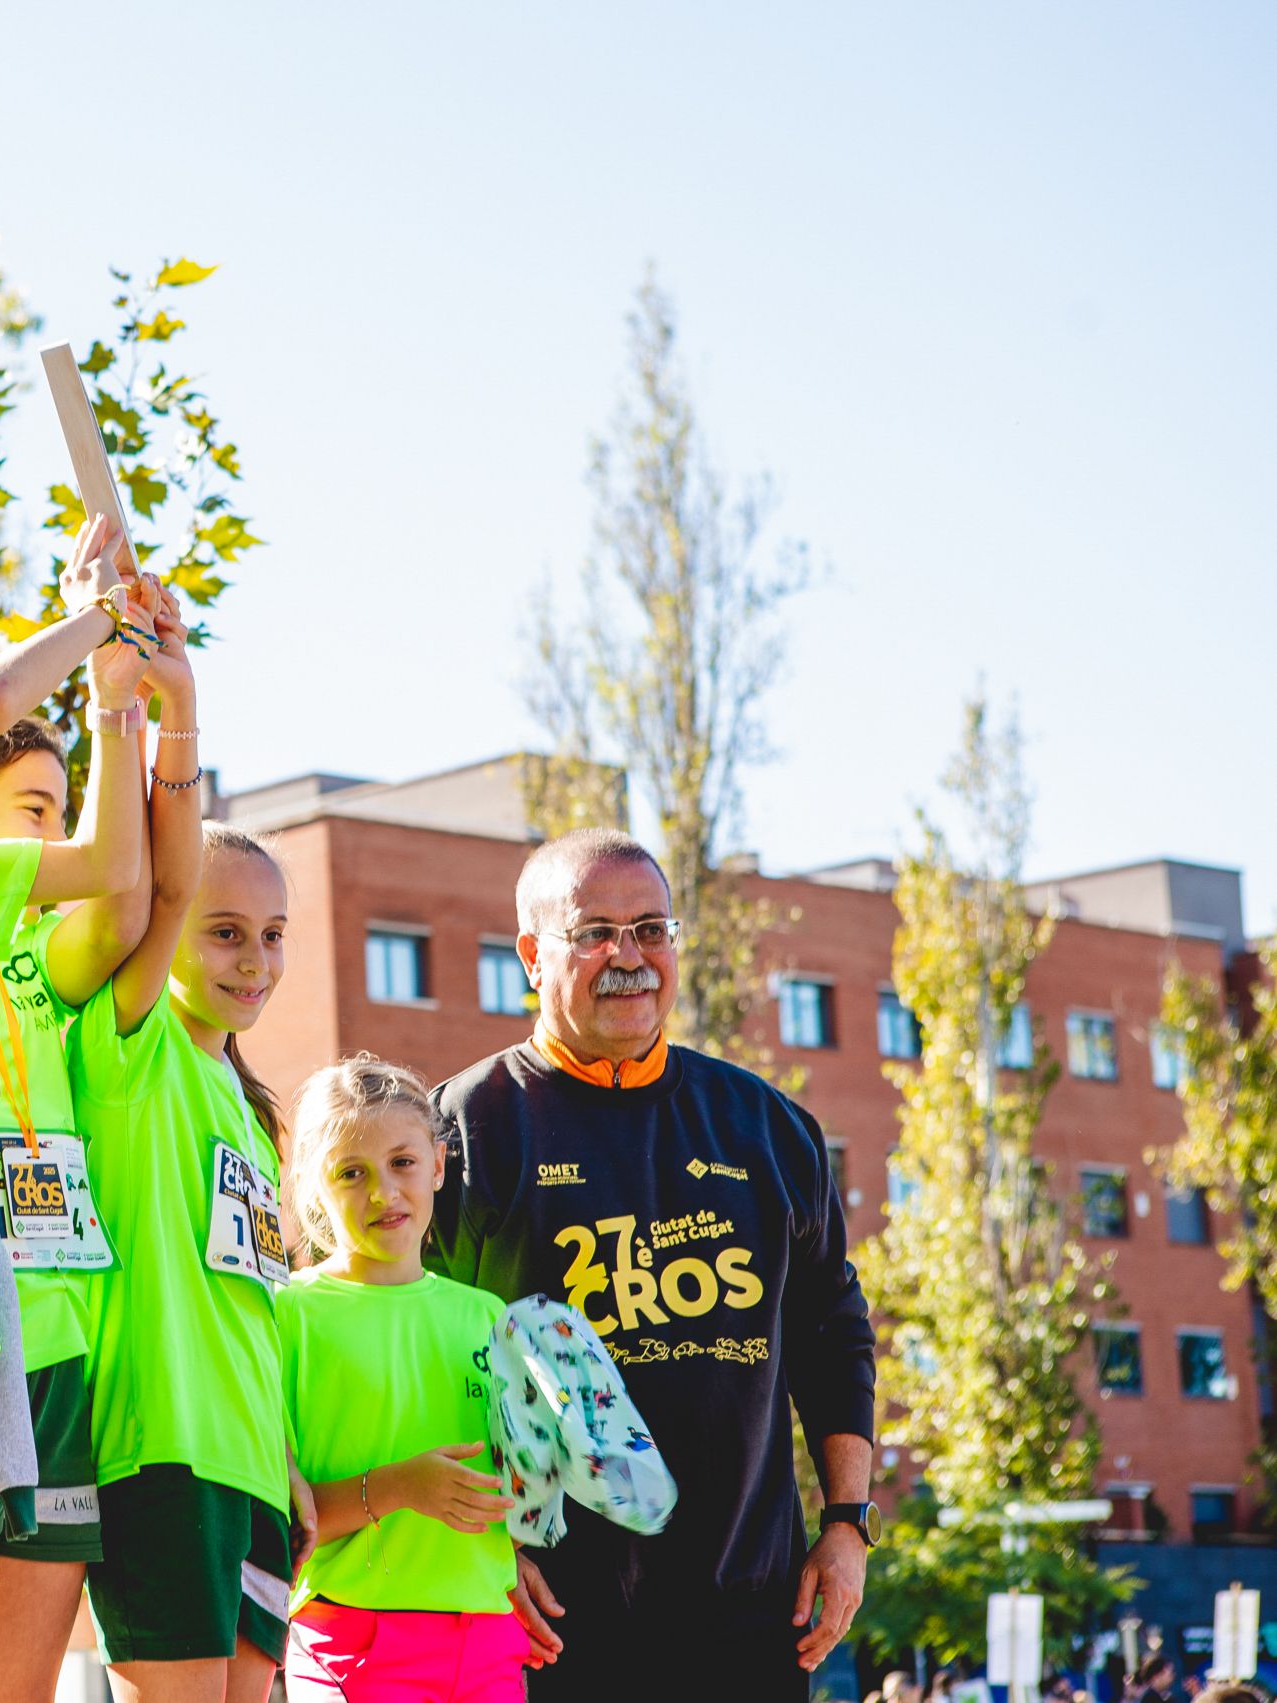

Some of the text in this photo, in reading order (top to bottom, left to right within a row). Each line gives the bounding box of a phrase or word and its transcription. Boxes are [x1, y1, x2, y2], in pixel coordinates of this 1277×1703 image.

[538, 1163, 579, 1177] OMET
[14, 1181, 64, 1206] CROS
[650, 1209, 716, 1236] Ciutat de
[652, 1219, 734, 1250] Sant Cugat
[567, 1247, 764, 1337] CROS
[466, 1376, 483, 1398] la
[54, 1496, 93, 1511] LA VALL
